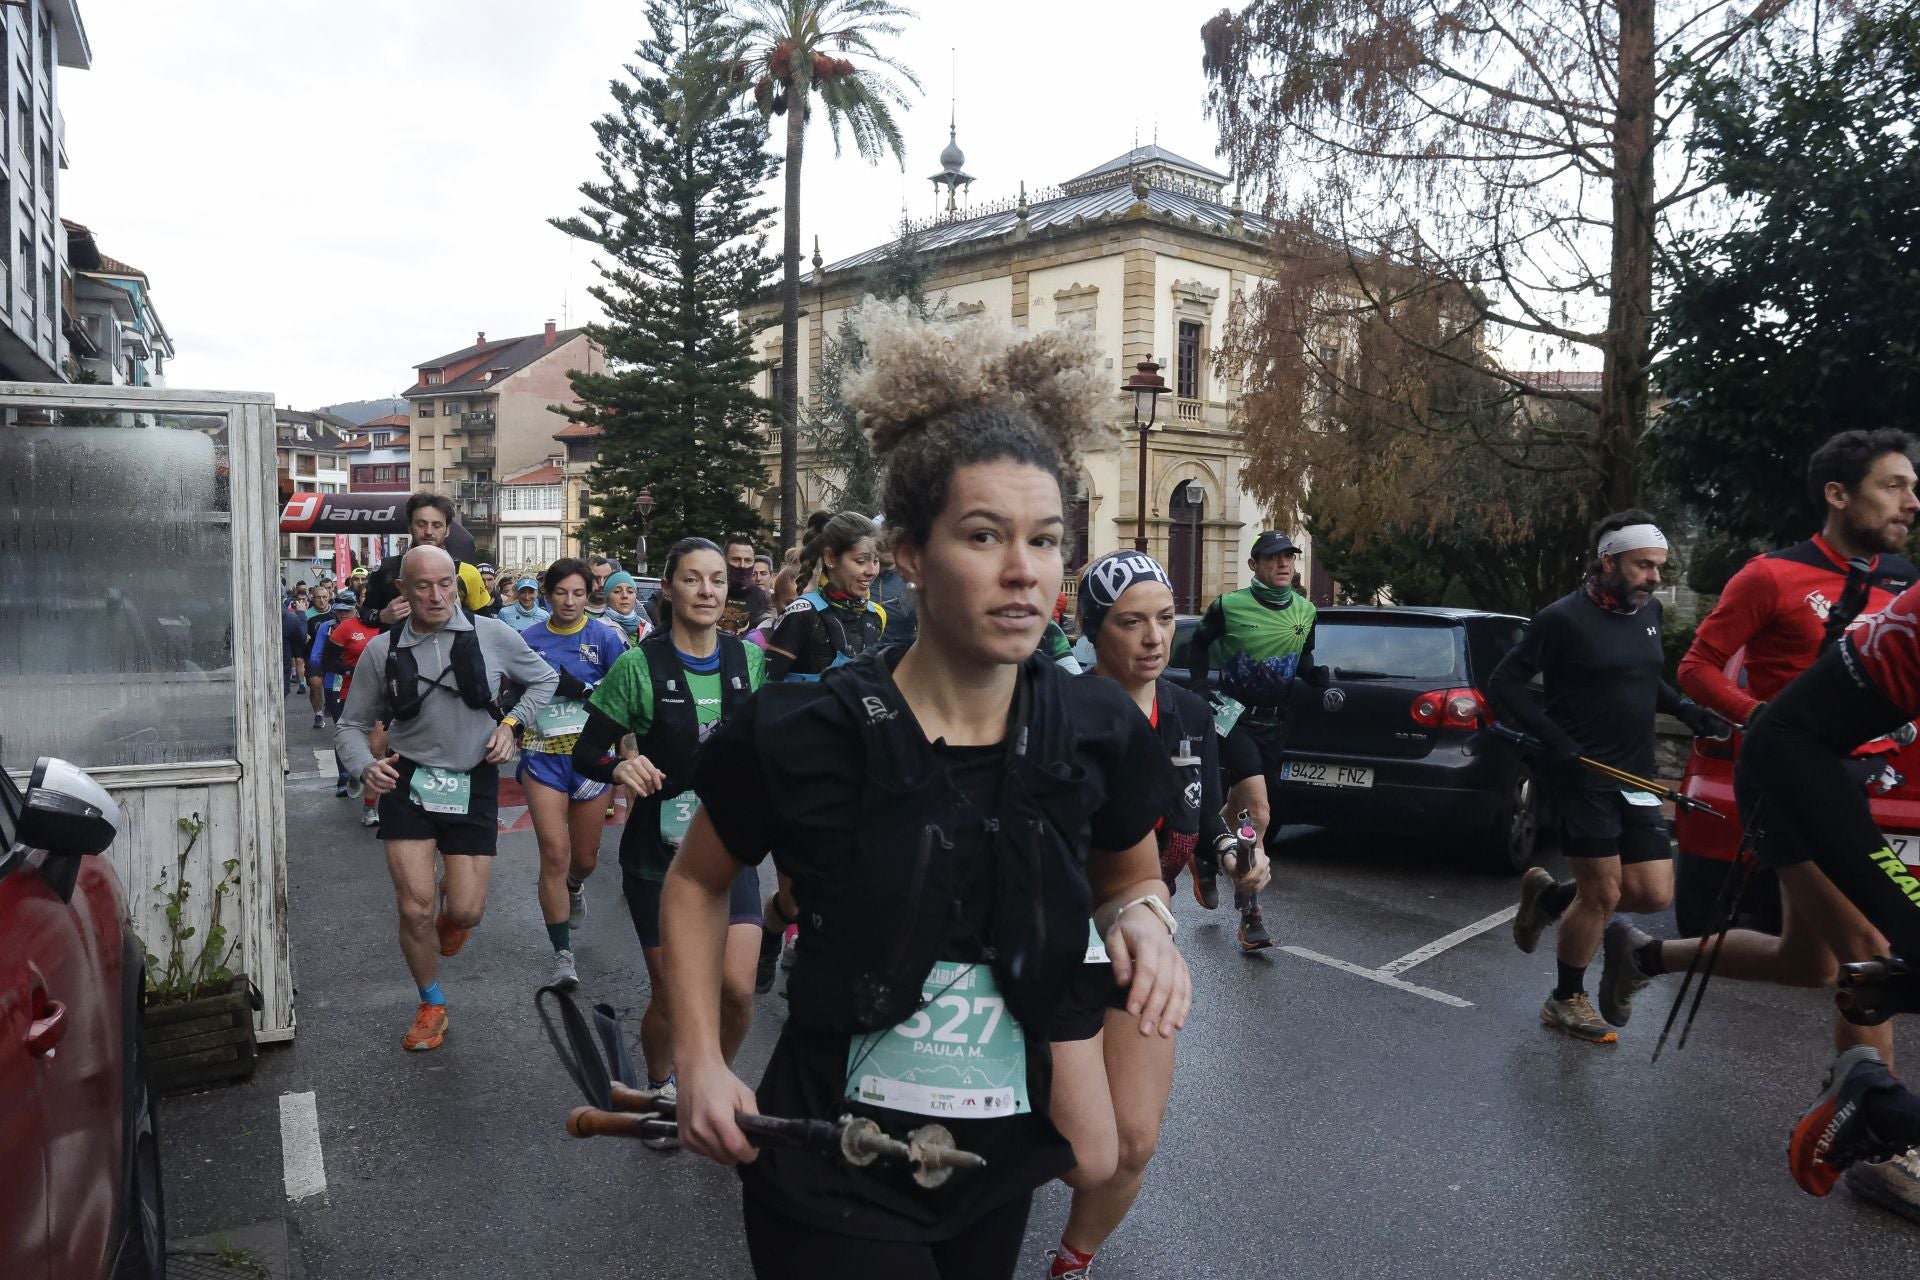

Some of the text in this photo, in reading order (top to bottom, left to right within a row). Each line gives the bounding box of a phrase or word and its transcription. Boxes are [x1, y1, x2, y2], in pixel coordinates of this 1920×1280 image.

[548, 703, 578, 718] 314
[1291, 763, 1327, 781] 9422
[1338, 767, 1368, 785] FNZ
[913, 1040, 984, 1058] PAULA M.
[1813, 1100, 1856, 1168] MERRELL
